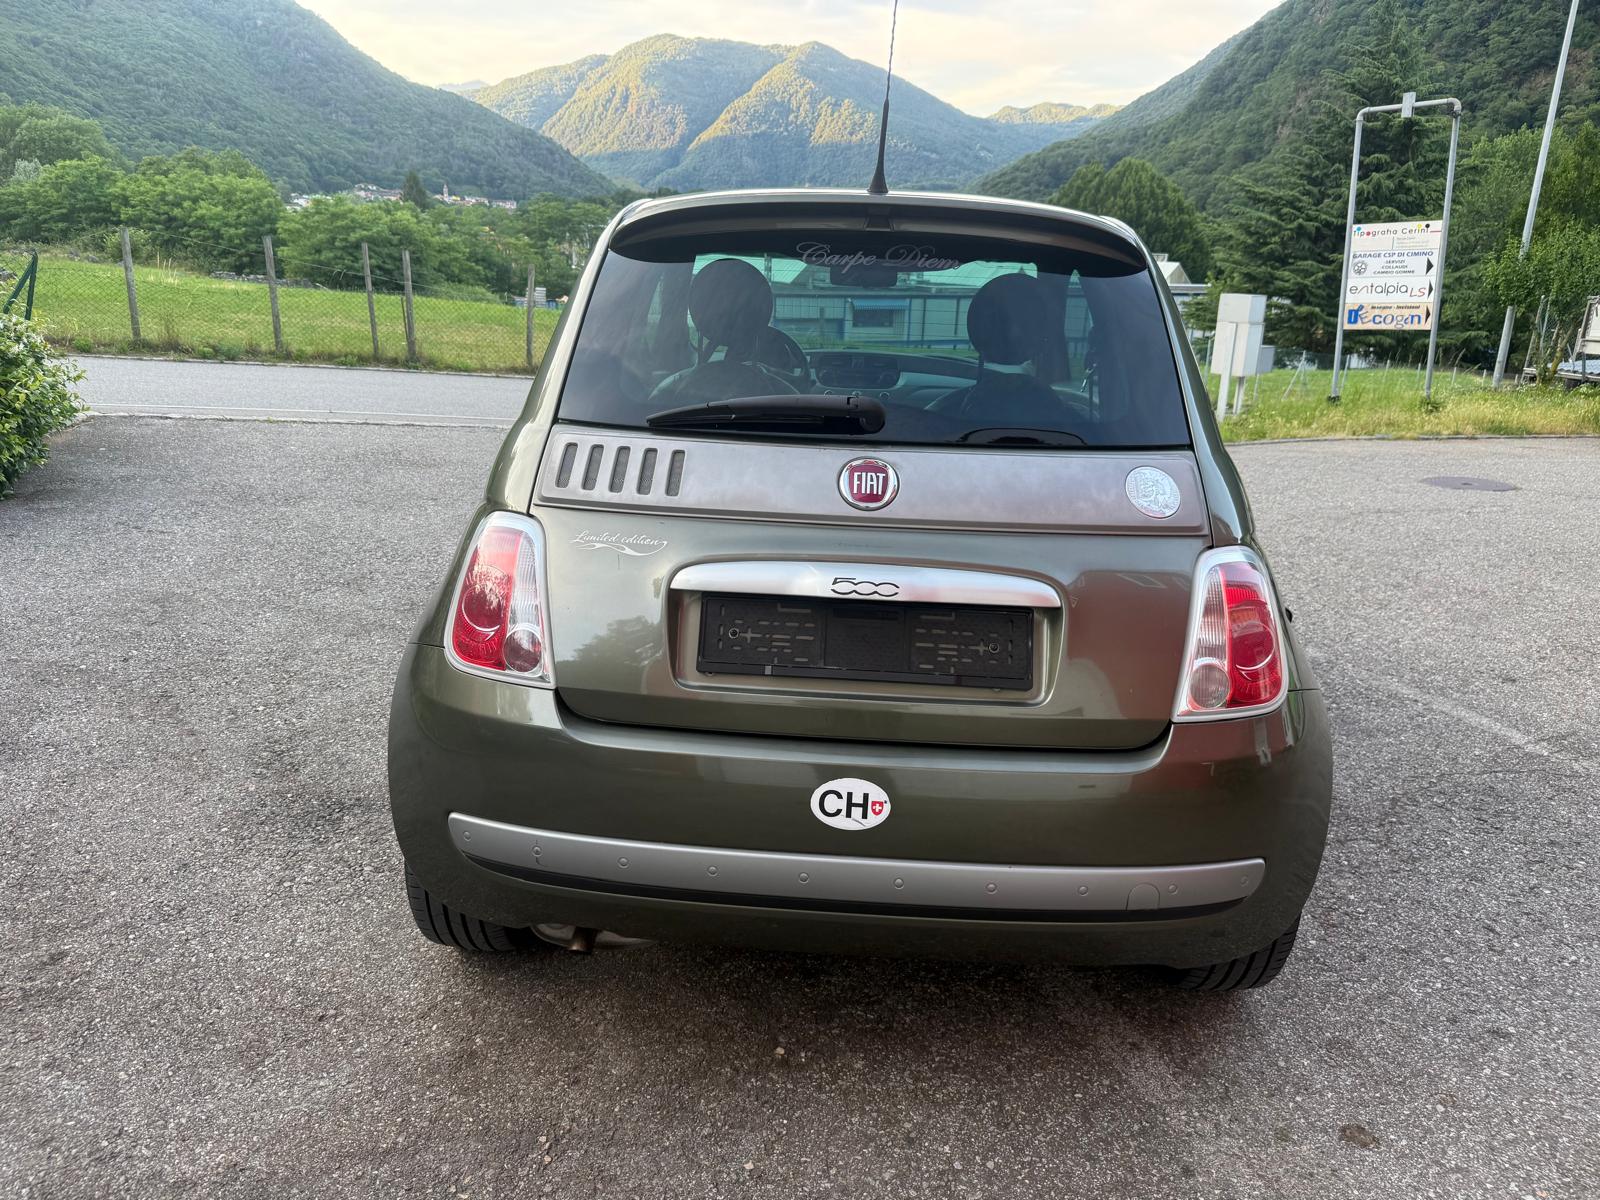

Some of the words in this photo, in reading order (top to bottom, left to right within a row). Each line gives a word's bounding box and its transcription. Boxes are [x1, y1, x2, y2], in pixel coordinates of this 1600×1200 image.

[1401, 224, 1430, 235] Cerini
[796, 241, 877, 274] Carpe
[880, 244, 960, 270] Diem
[1349, 282, 1408, 296] entalpia
[1409, 287, 1426, 297] LS
[853, 472, 886, 495] FIAT
[569, 530, 620, 543] Limited
[621, 534, 661, 545] edition
[831, 577, 899, 597] 500
[819, 789, 869, 819] CH
